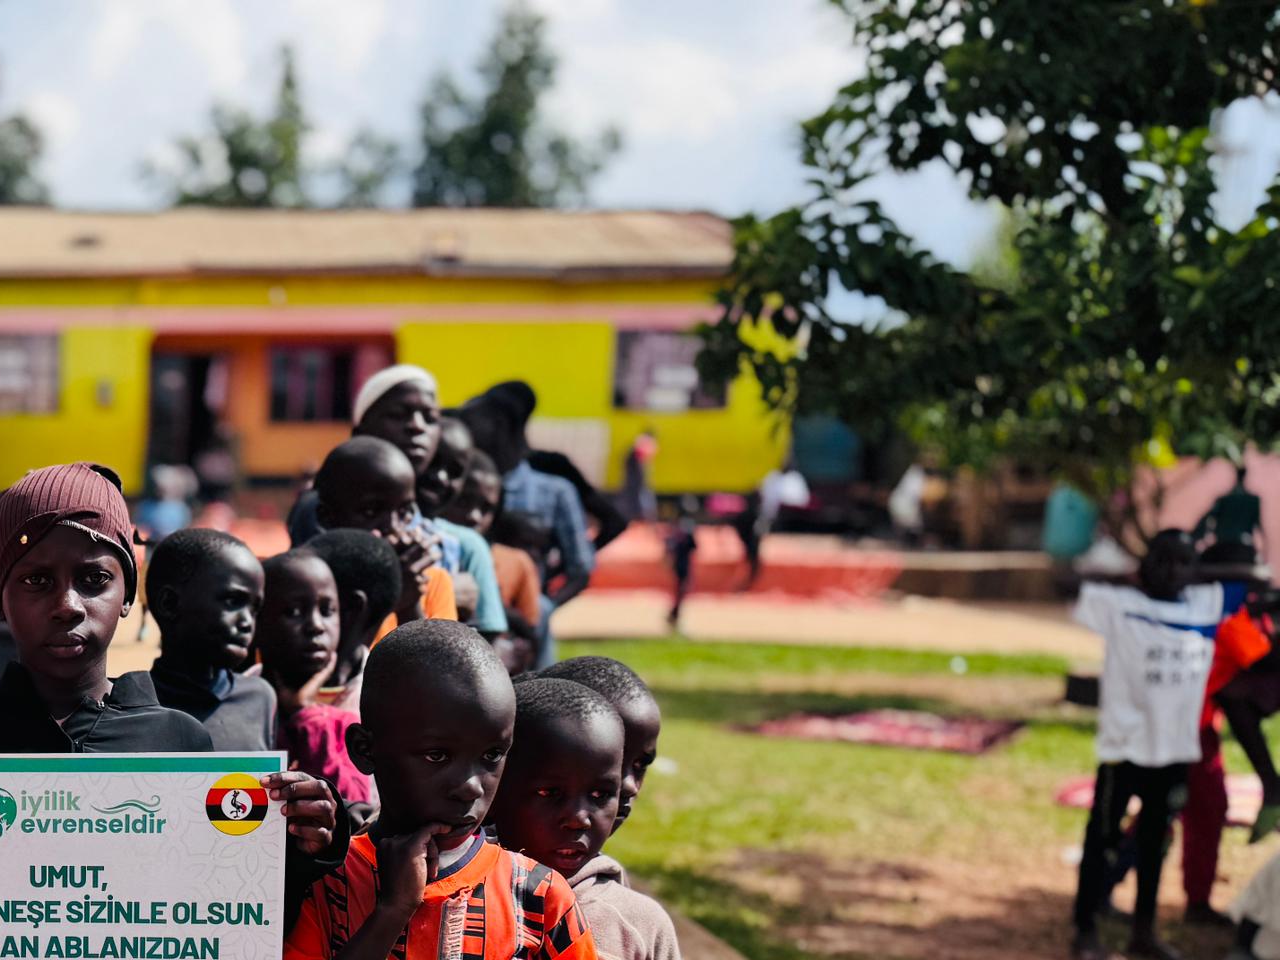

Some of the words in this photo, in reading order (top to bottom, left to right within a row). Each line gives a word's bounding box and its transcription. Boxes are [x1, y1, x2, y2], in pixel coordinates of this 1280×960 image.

[20, 790, 81, 812] iyilik
[20, 813, 167, 834] evrenseldir
[29, 866, 109, 892] UMUT,
[66, 895, 168, 925] SİZİNLE
[172, 902, 271, 926] OLSUN.
[45, 936, 220, 960] ABLANIZDAN
